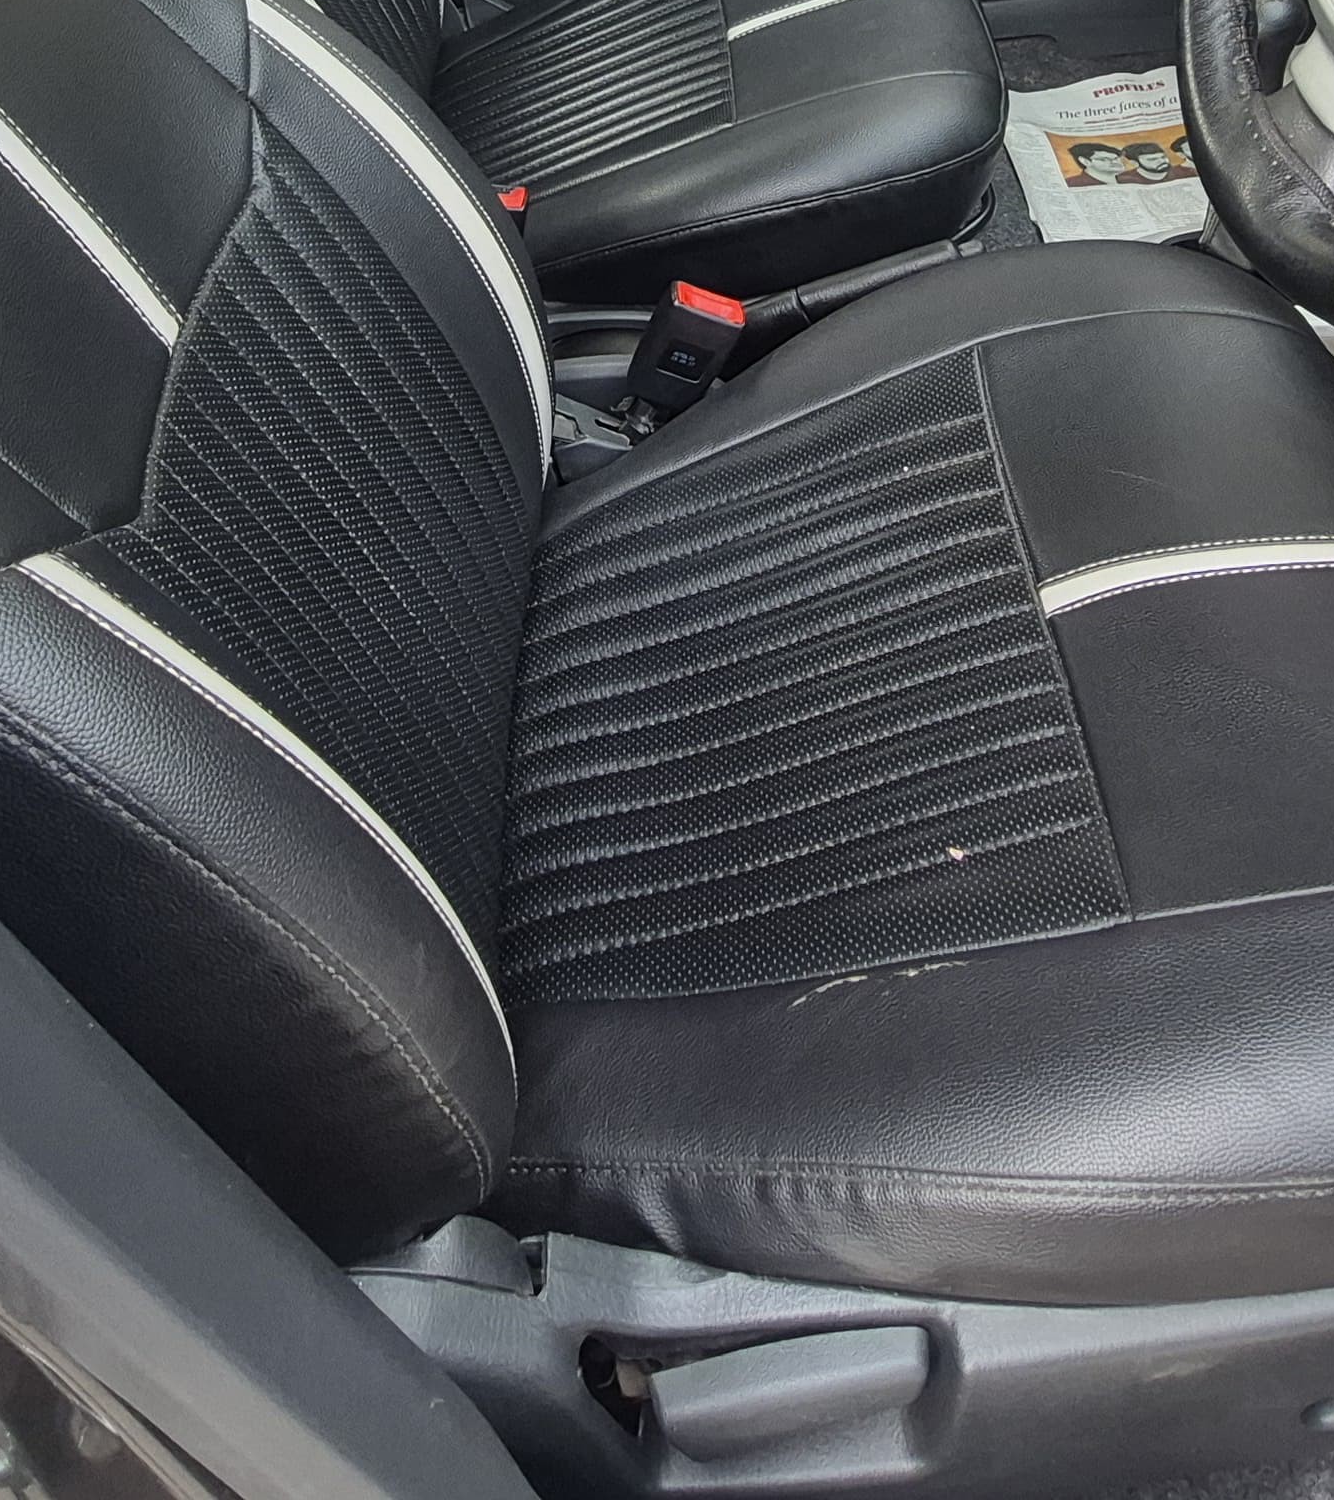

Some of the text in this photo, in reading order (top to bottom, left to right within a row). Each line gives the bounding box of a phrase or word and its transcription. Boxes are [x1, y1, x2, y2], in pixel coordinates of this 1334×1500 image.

[1092, 80, 1166, 99] PROFILES
[1055, 109, 1081, 120] The
[1084, 104, 1117, 118] three
[1118, 100, 1152, 114] faces
[1153, 96, 1167, 109] of
